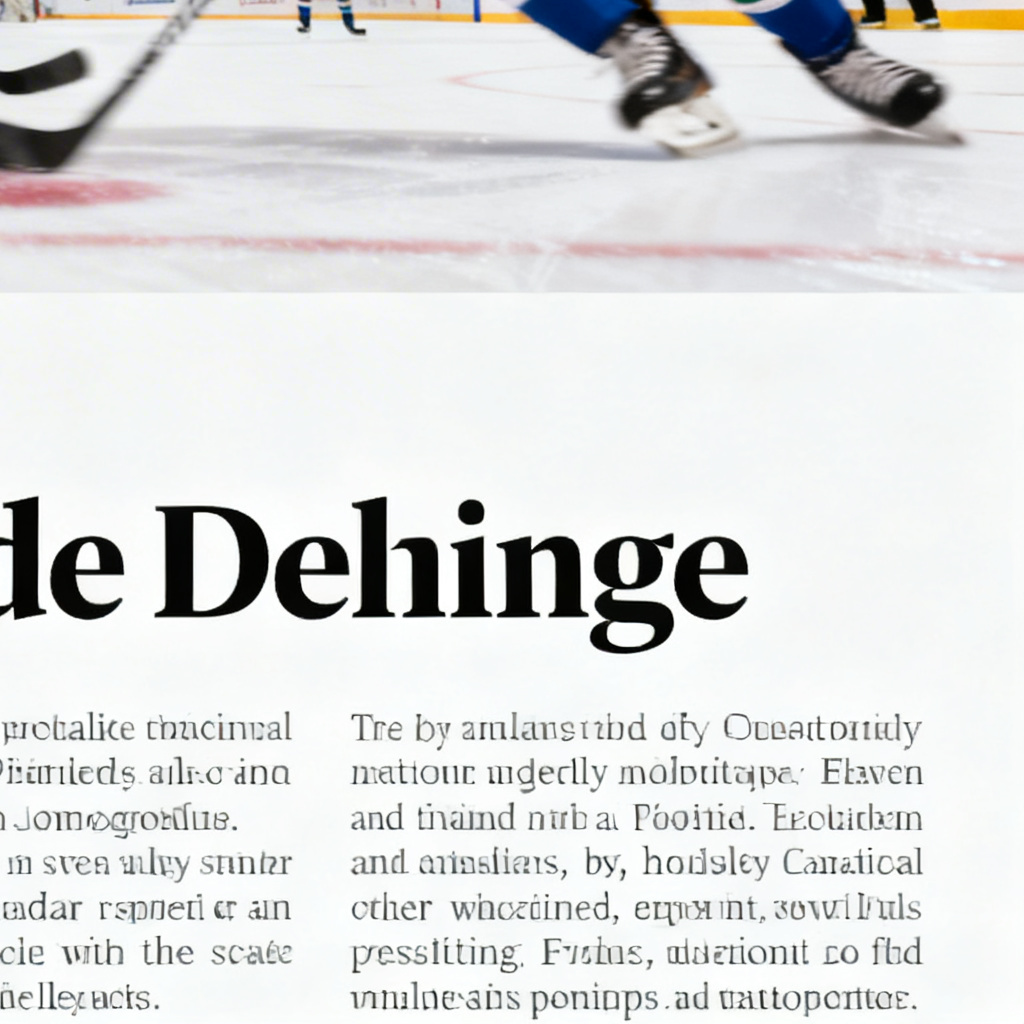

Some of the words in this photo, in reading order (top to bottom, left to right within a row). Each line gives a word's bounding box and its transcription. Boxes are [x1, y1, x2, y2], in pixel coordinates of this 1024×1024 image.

[155, 496, 749, 655] Dehinge
[416, 714, 451, 751] by
[351, 803, 404, 830] and
[351, 848, 409, 875] and
[585, 847, 626, 881] by,
[143, 936, 193, 965] the
